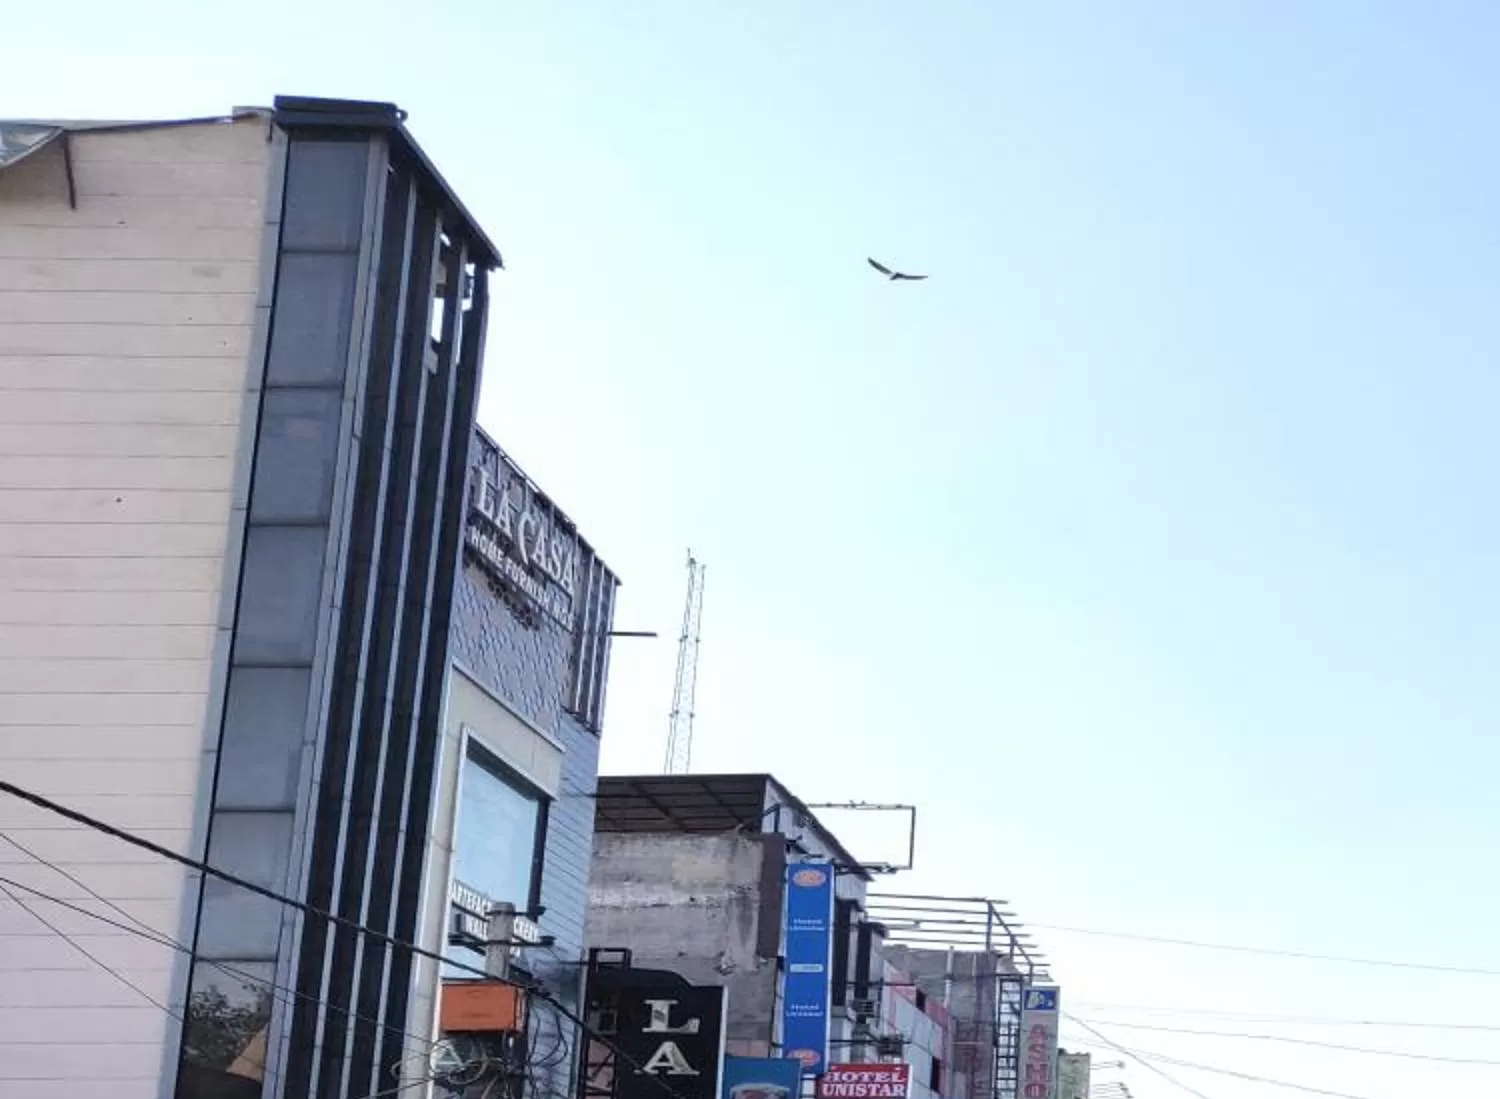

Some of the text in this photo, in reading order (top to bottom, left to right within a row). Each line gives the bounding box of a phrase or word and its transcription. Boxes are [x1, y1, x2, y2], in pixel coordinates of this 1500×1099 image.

[476, 466, 574, 597] LA CASA
[824, 1071, 905, 1082] HOTEL
[822, 1083, 905, 1097] UNISTAR
